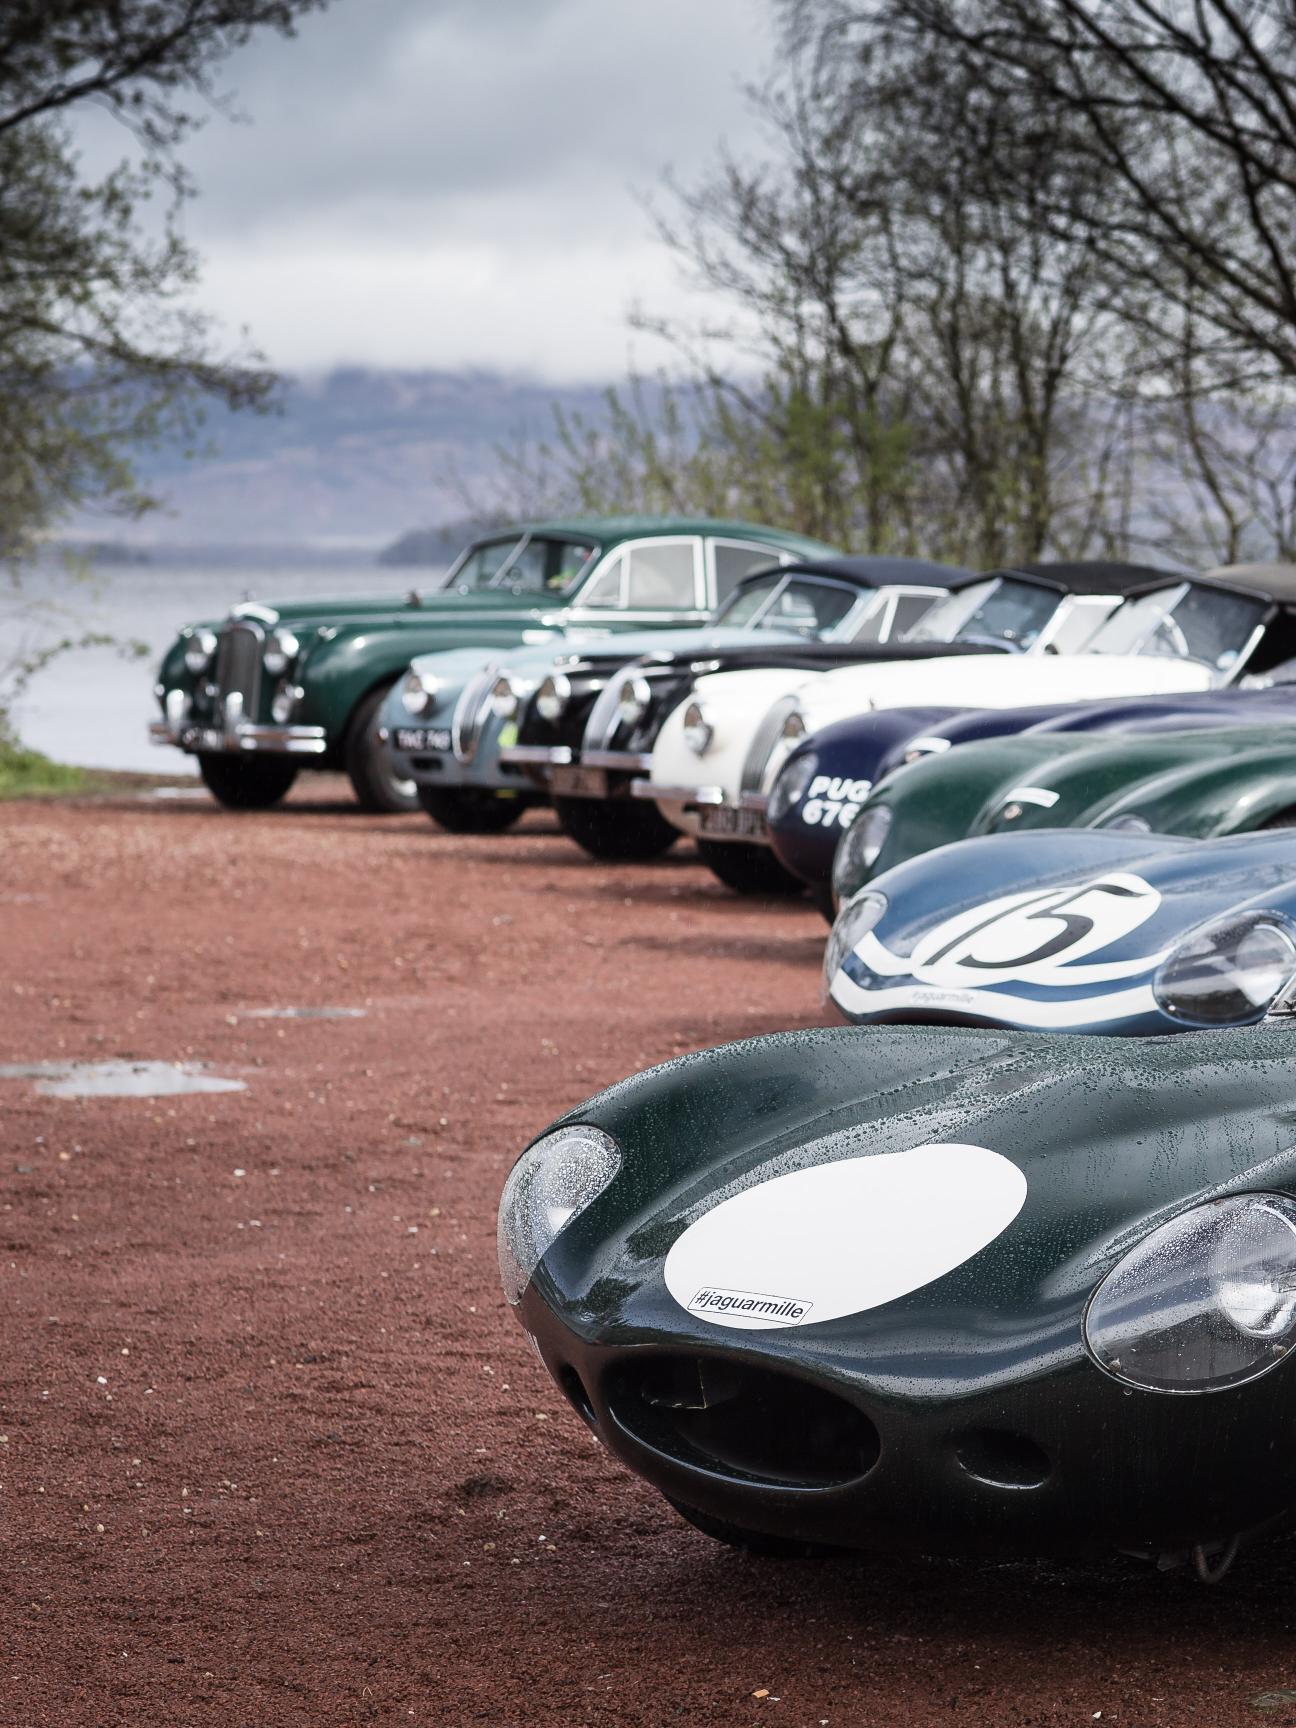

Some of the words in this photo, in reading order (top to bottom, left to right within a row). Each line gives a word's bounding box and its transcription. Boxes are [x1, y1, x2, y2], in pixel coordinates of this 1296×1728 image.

[808, 775, 872, 803] PUG
[920, 883, 1148, 969] 15
[694, 1290, 804, 1319] #jaguarmille
